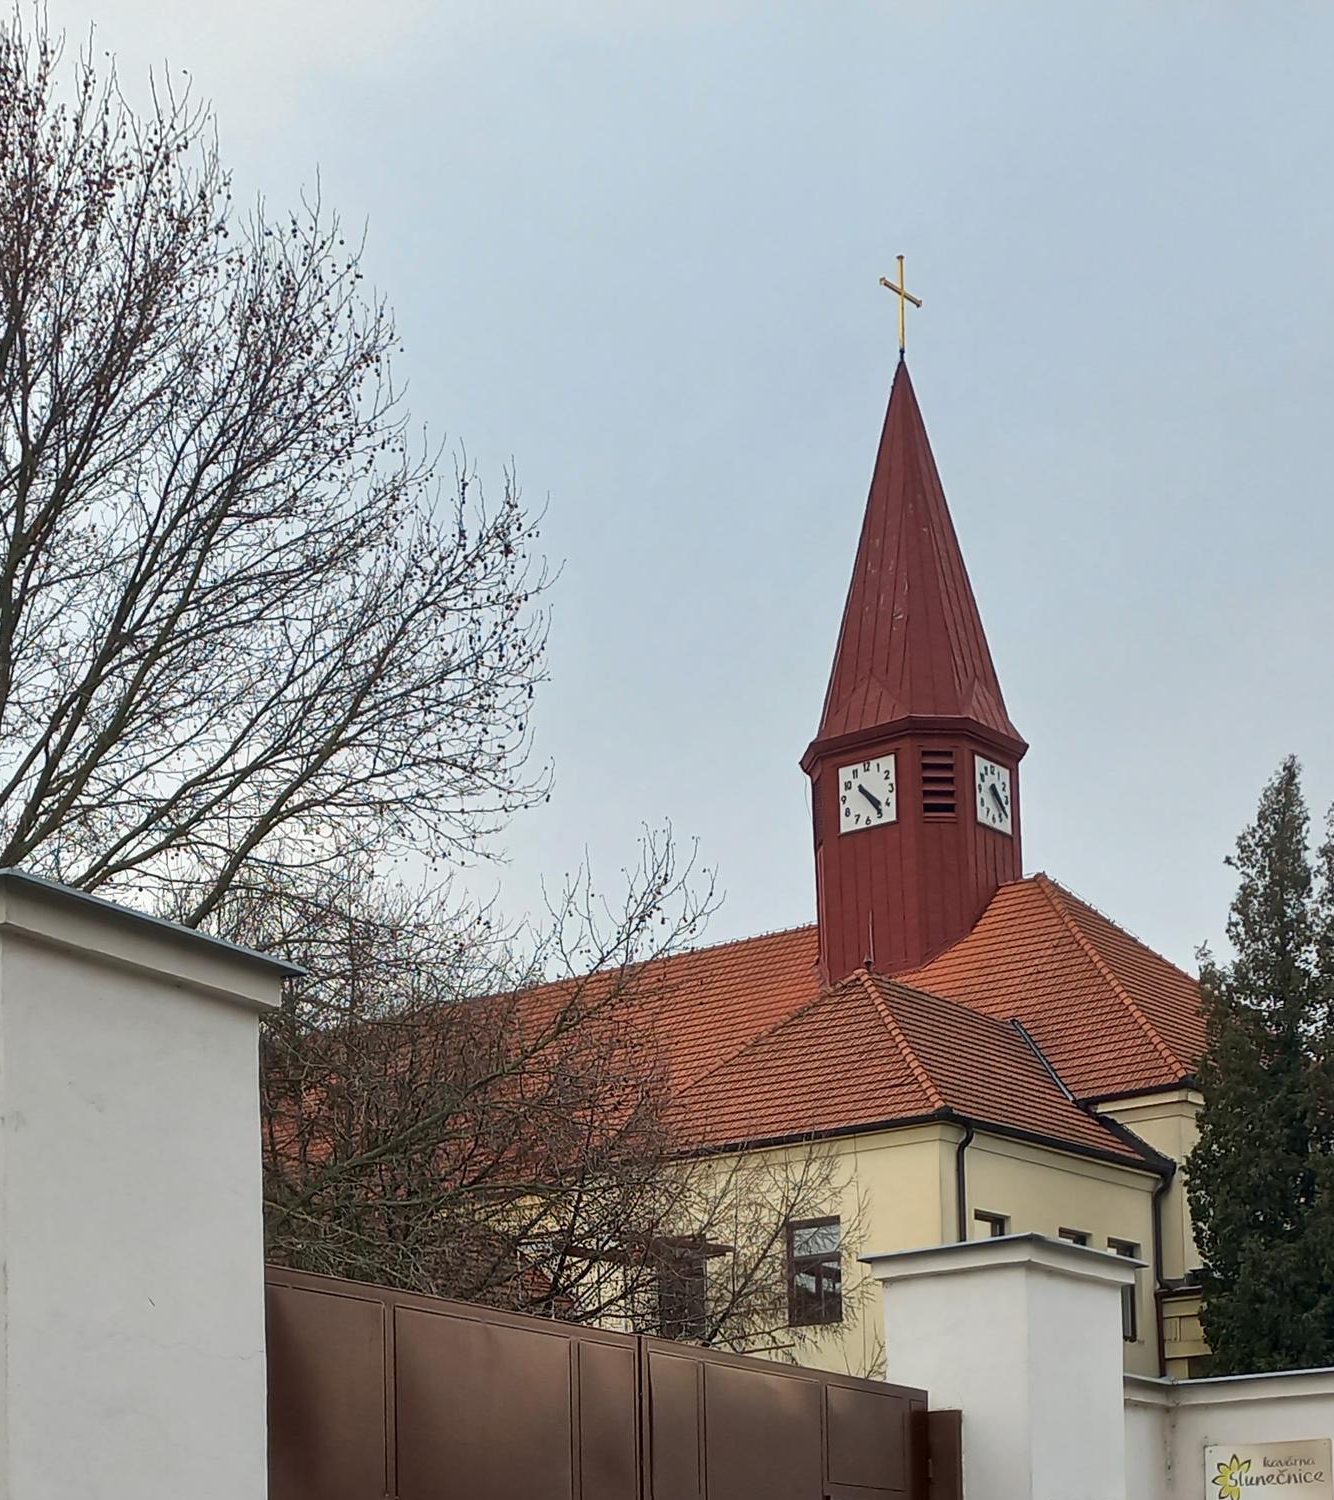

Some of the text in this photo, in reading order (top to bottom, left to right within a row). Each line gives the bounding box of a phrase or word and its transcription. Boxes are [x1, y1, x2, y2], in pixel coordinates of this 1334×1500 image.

[863, 761, 871, 772] 12
[876, 763, 880, 773] 1
[852, 768, 858, 779] 11
[884, 770, 890, 780] 2
[844, 780, 852, 791] 10
[888, 783, 894, 793] 3
[1002, 781, 1006, 792] 2
[841, 795, 847, 805] 9
[885, 797, 891, 807] 4
[1004, 795, 1009, 805] 3
[845, 807, 851, 817] 8
[986, 806, 990, 817] 7
[854, 814, 861, 825] 7
[865, 815, 871, 825] 6
[1263, 1456, 1316, 1467] kavárna
[1229, 1468, 1325, 1487] Slunečnice
